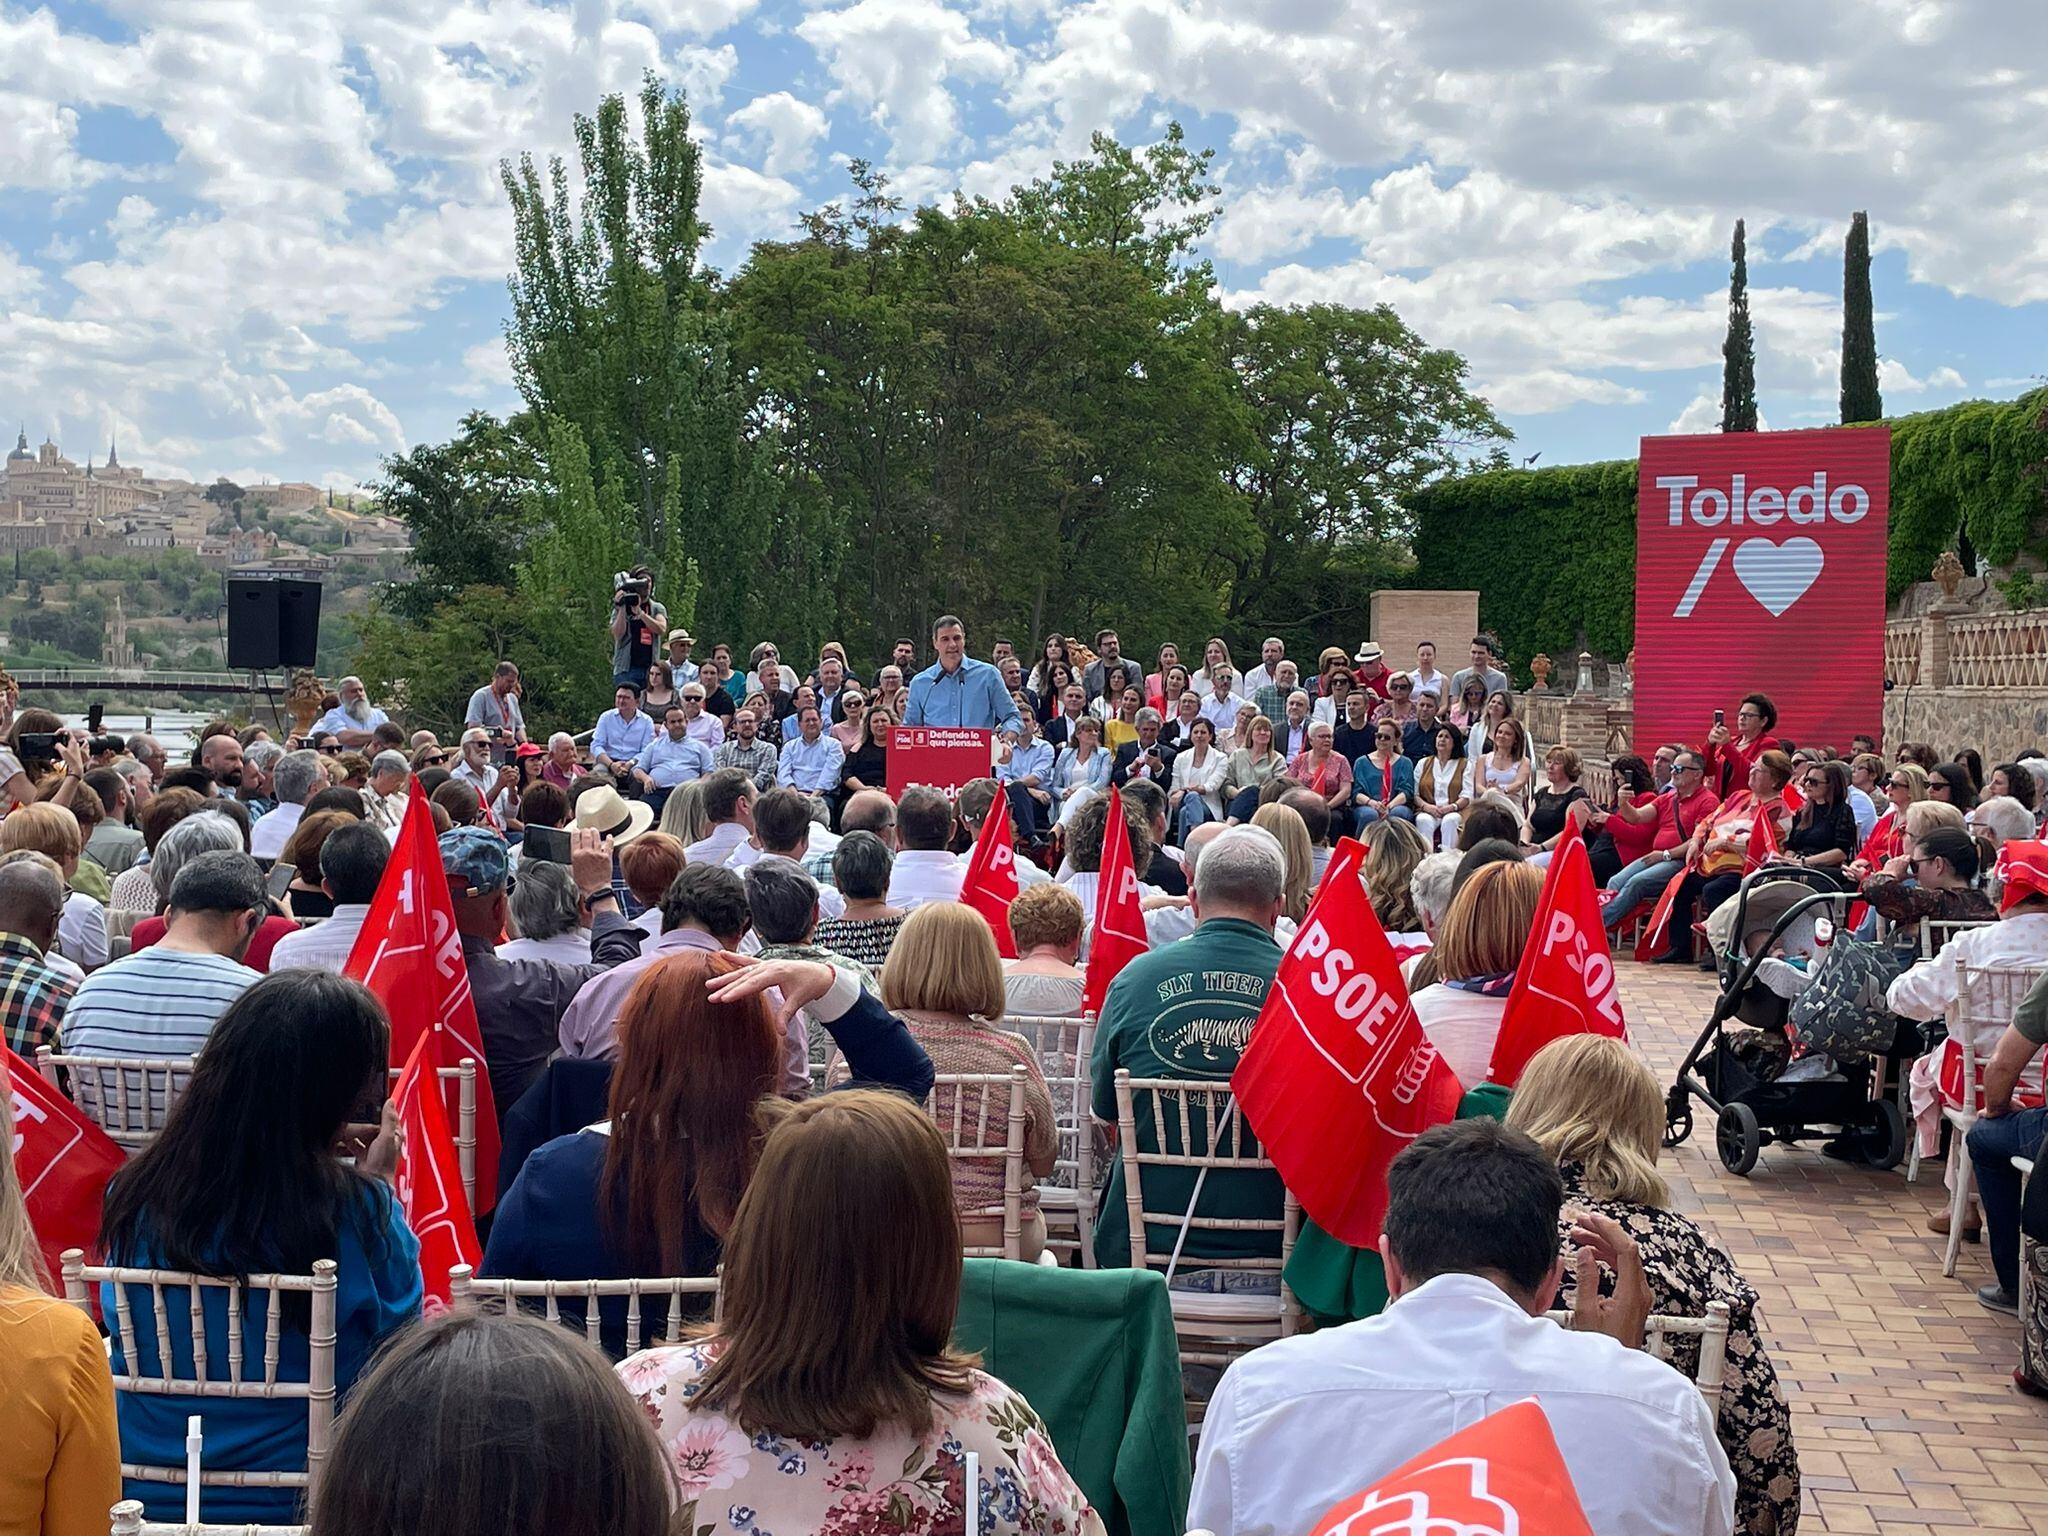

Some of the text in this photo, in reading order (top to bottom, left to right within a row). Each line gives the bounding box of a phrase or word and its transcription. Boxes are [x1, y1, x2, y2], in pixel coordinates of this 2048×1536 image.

[1656, 471, 1870, 527] Toledo
[929, 740, 946, 748] que
[970, 731, 979, 739] lo
[1156, 970, 1265, 1002] SLY TIGER
[1293, 918, 1399, 1047] PSOE
